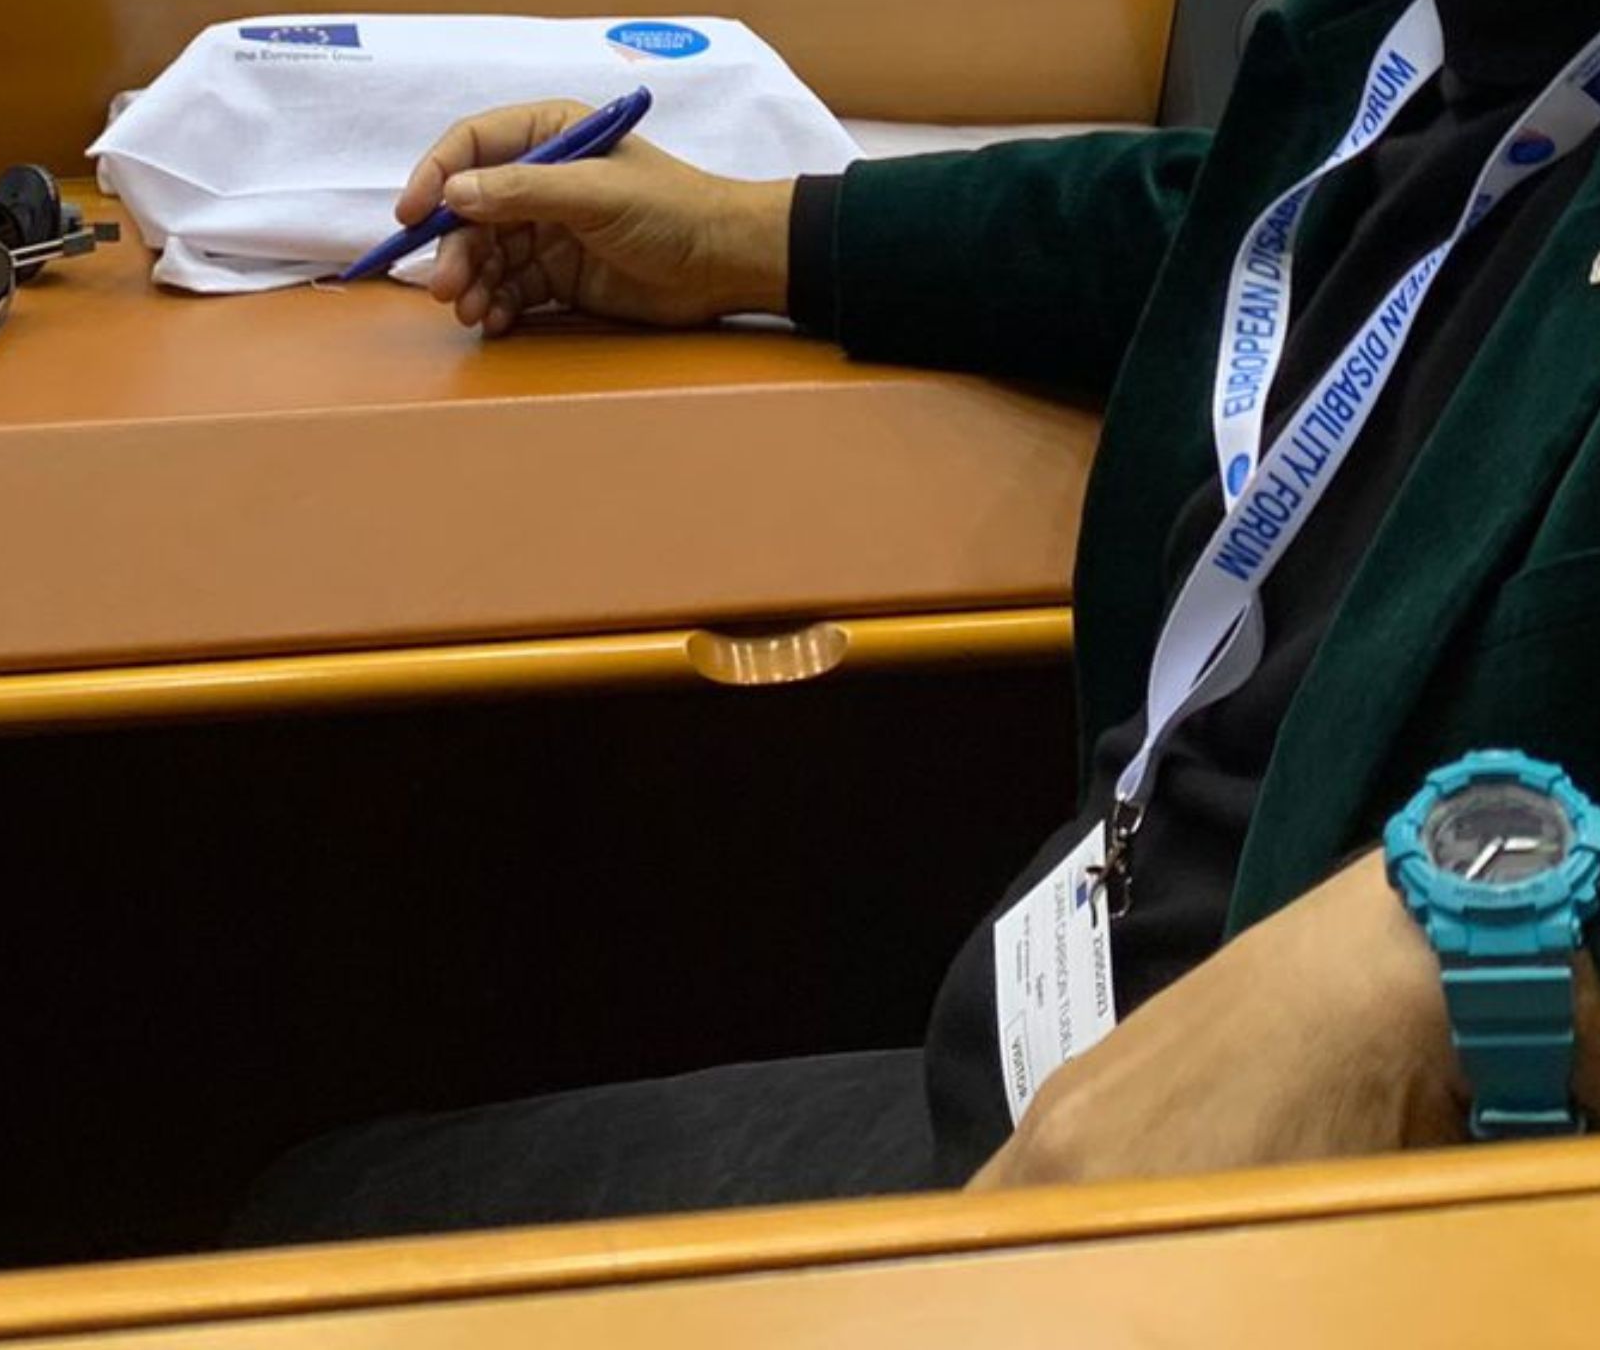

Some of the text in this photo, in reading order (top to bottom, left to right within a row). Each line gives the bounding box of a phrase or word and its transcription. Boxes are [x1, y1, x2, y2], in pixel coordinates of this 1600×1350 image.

[1224, 283, 1282, 419] EUROPEAN
[1351, 49, 1419, 147] FORUM
[1281, 321, 1391, 488] DISABILITY
[1213, 473, 1302, 582] FORUM
